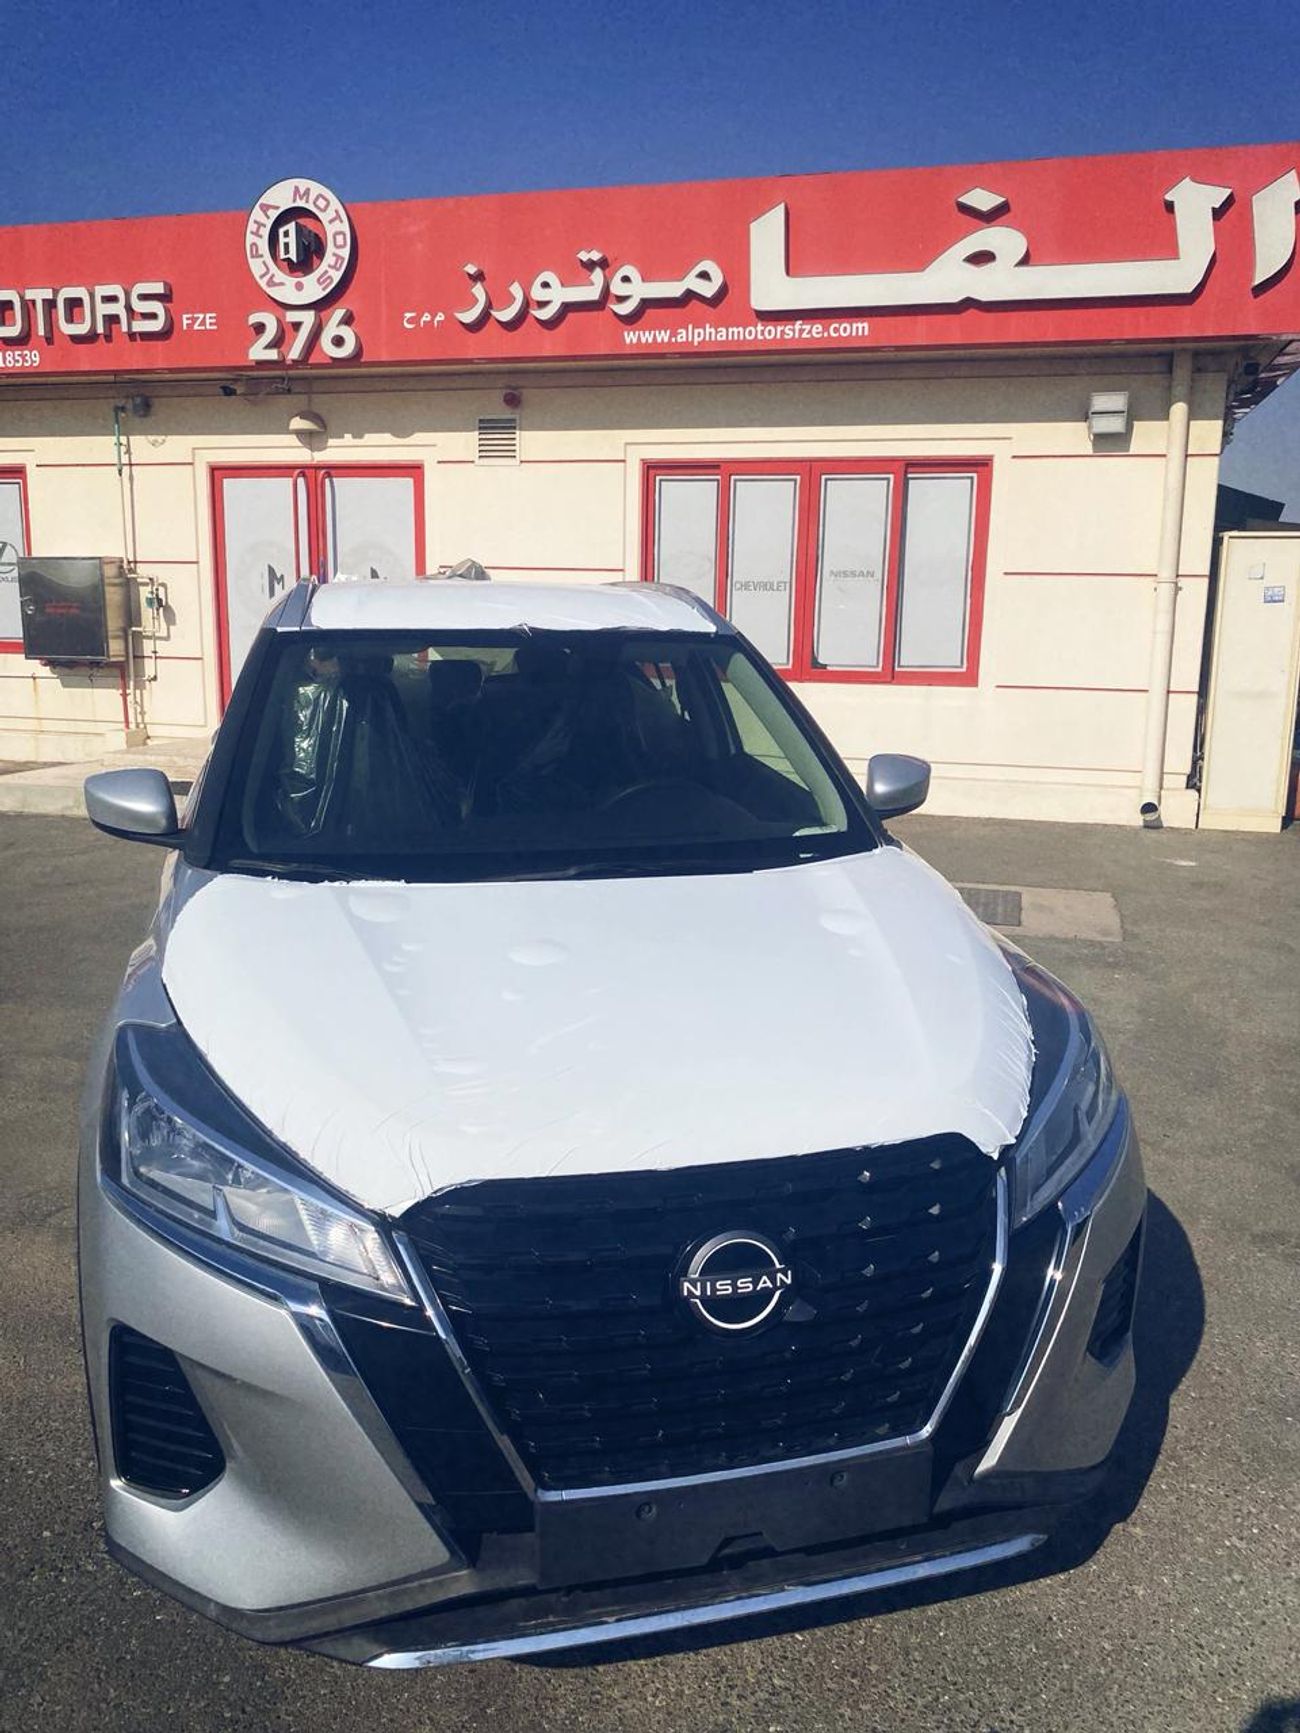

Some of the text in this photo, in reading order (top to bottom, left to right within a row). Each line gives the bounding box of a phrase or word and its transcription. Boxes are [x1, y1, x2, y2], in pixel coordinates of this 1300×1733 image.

[249, 185, 347, 292] ALPHA MOTORS
[455, 249, 725, 324] موتورز
[182, 312, 218, 331] FZE
[248, 308, 356, 360] 276
[623, 320, 870, 346] www.alphamotorsfze.com
[734, 580, 788, 591] CHEVROLET
[829, 569, 876, 578] NISSAN
[683, 1270, 793, 1296] NISSAN
